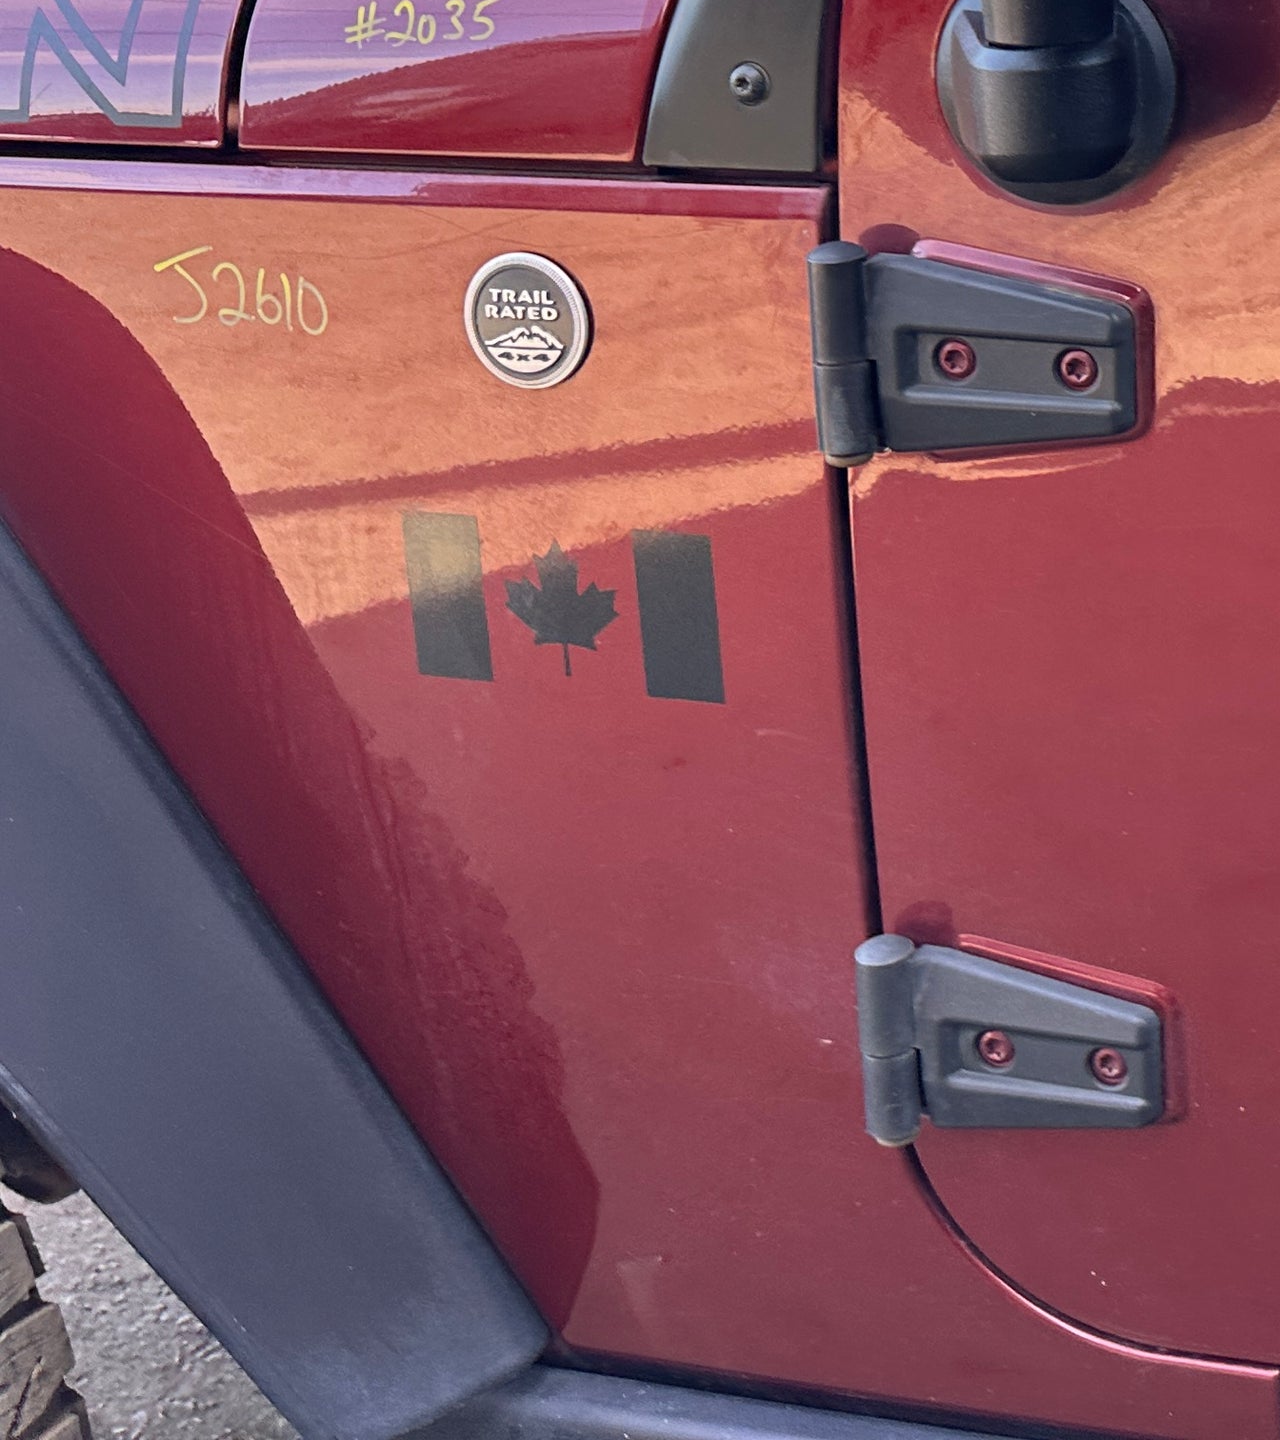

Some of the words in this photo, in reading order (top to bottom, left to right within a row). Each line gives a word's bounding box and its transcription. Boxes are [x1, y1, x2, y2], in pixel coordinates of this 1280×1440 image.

[153, 246, 330, 336] J2610
[488, 288, 555, 305] TRAIL
[484, 304, 558, 321] RATED
